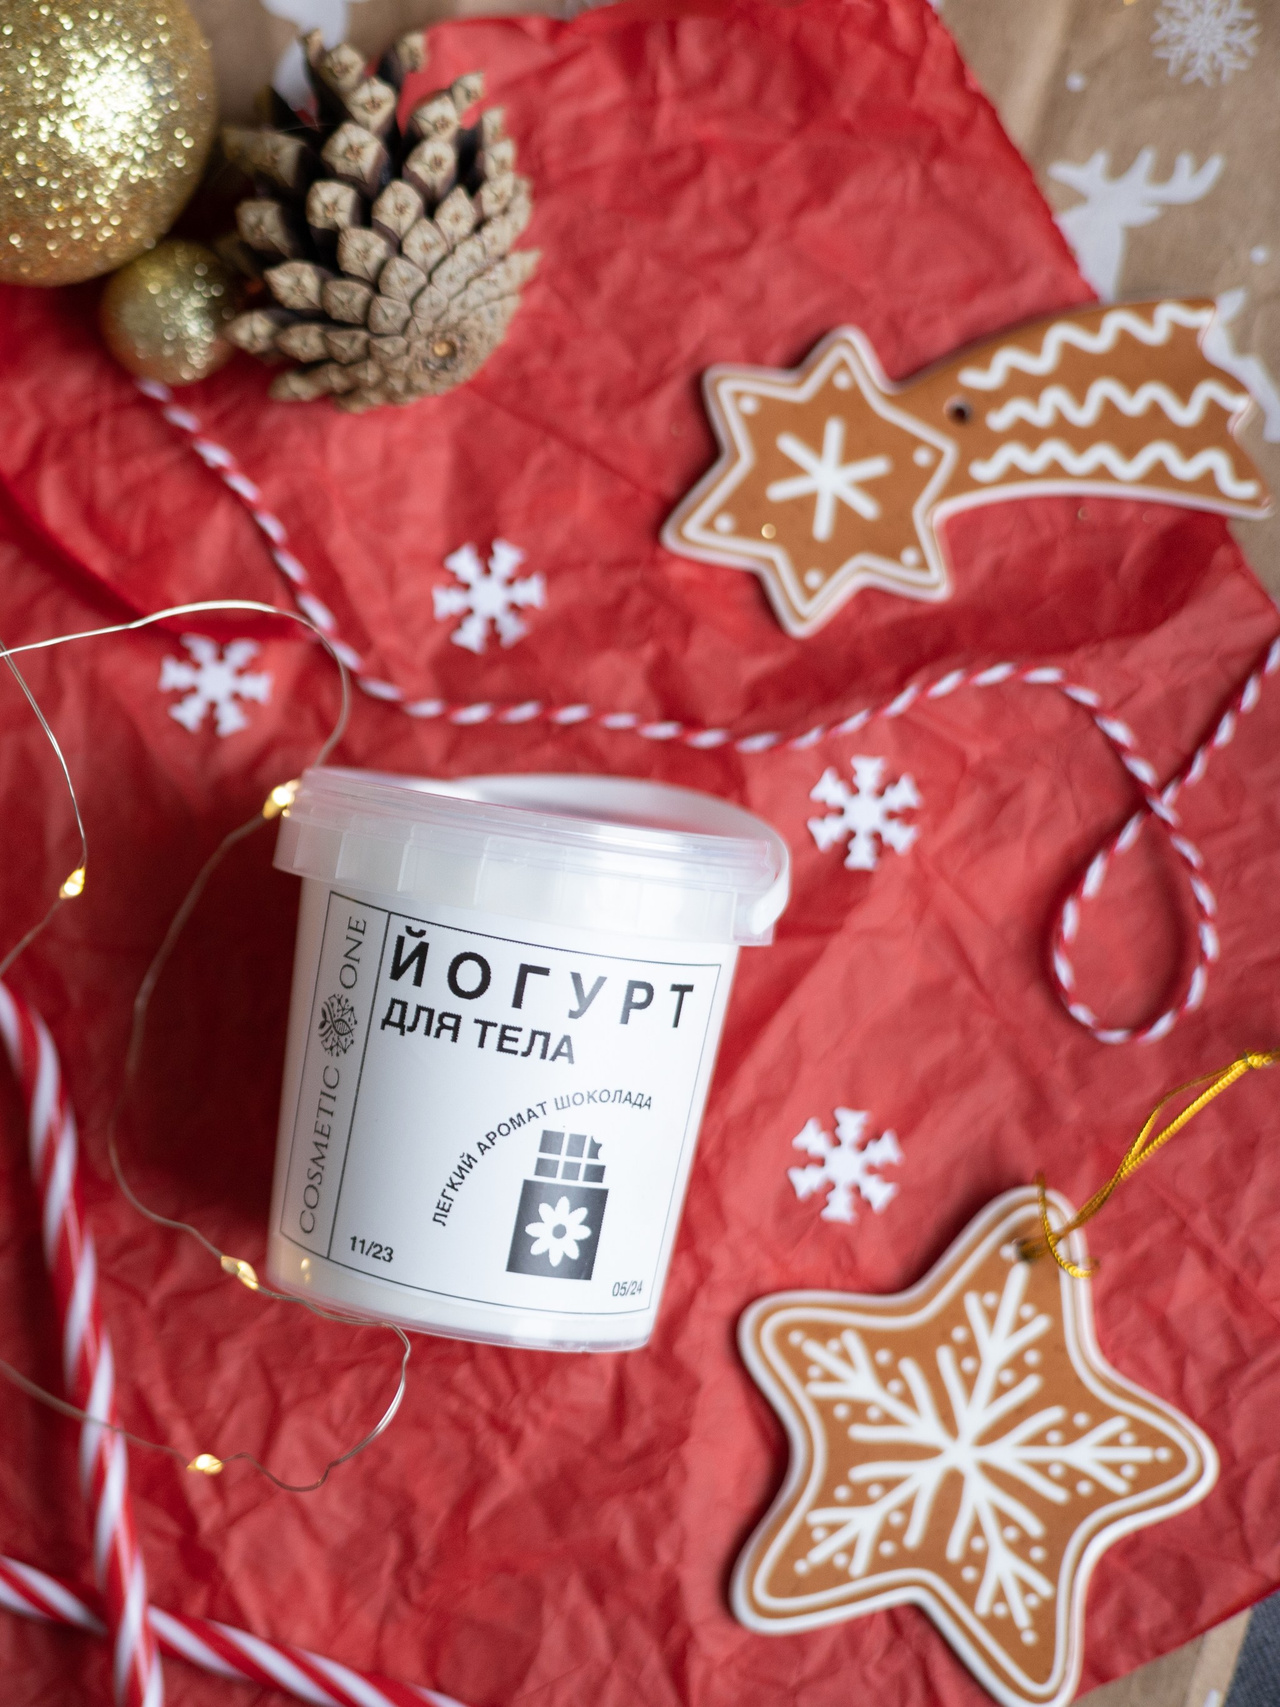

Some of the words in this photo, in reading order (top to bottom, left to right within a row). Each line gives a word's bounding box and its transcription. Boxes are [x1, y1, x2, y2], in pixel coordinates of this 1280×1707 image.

[388, 925, 695, 1030] ЙОГУРТ
[380, 997, 462, 1044] ДЛЯ
[473, 1018, 576, 1065] ТЕЛА
[299, 1065, 340, 1235] COSMETIC
[339, 915, 367, 990] ONE
[432, 1151, 478, 1227] ЛЕГКИЙ
[476, 1100, 549, 1158] АРОМАТ
[553, 1088, 653, 1112] ШОКОЛАДА
[349, 1235, 394, 1263] 11/23
[612, 1279, 643, 1297] 05/24
